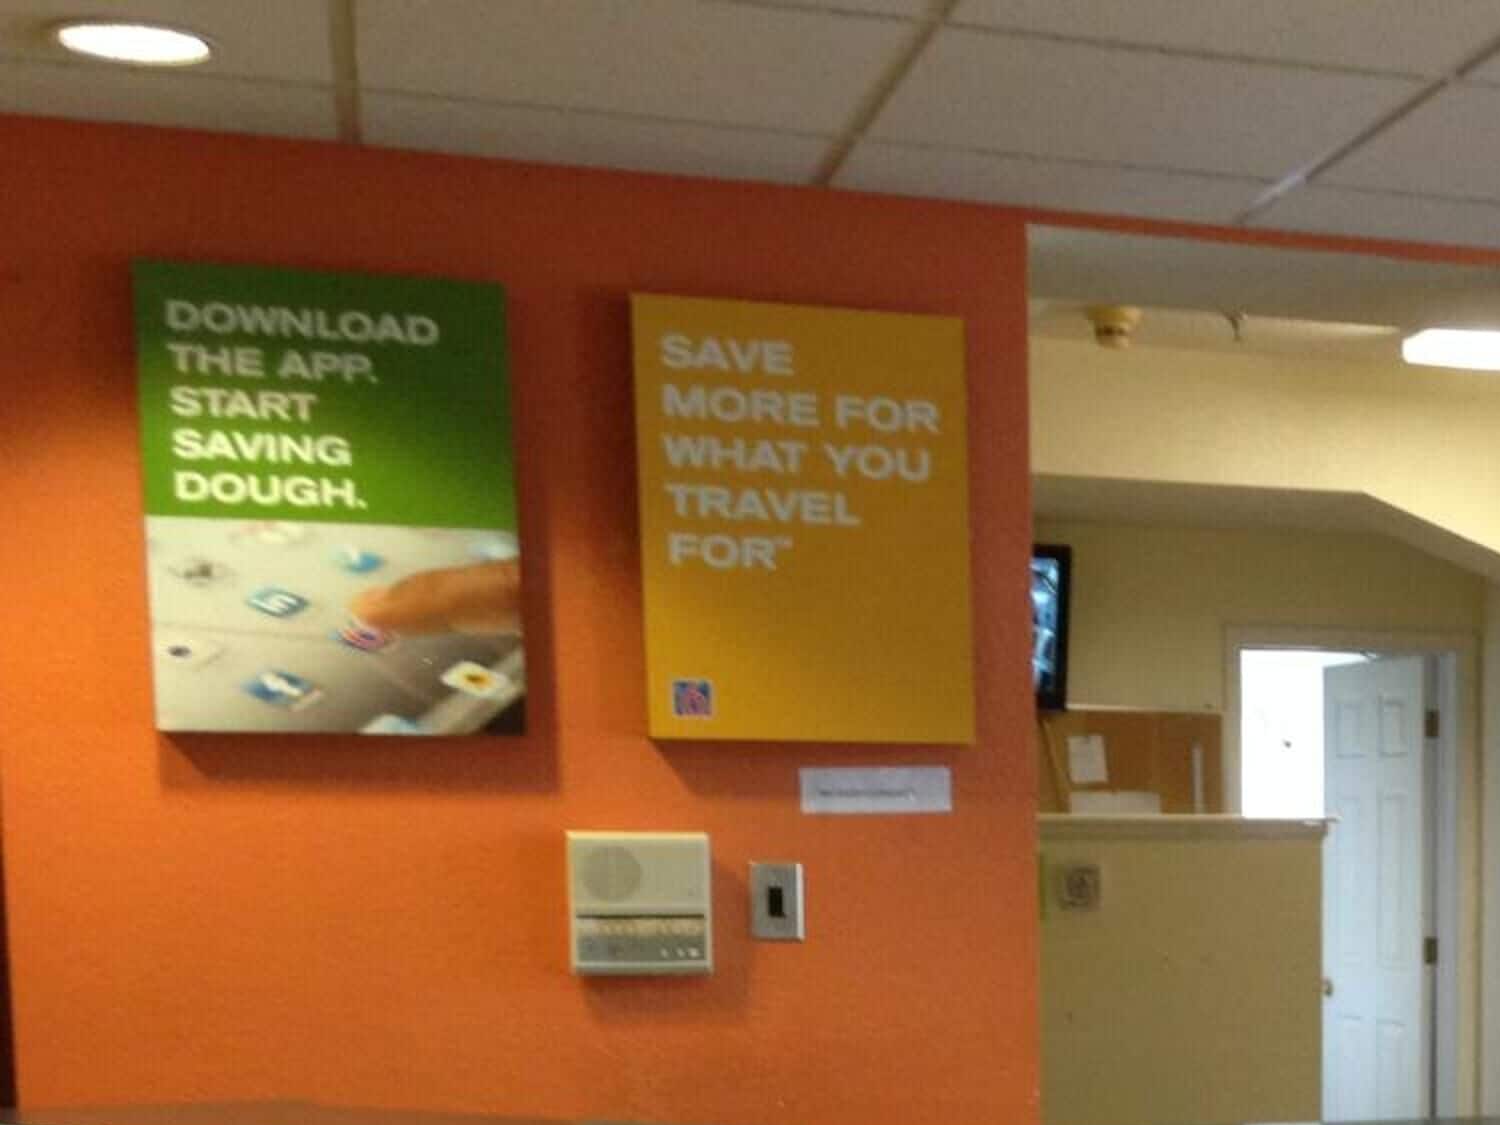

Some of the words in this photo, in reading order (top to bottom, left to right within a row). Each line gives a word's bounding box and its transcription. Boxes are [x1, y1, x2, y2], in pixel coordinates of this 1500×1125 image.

[165, 300, 440, 345] DOWNLOAD
[168, 343, 265, 378] THE
[279, 352, 377, 383] APP.
[661, 334, 793, 375] SAVE
[171, 385, 316, 421] START
[662, 384, 820, 427] MORE
[835, 396, 942, 434] FOR
[172, 427, 352, 466] SAVING
[663, 435, 807, 473] WHAT
[824, 445, 931, 482] YOU
[173, 473, 367, 509] DOUGH.
[664, 483, 860, 526] TRAVEL
